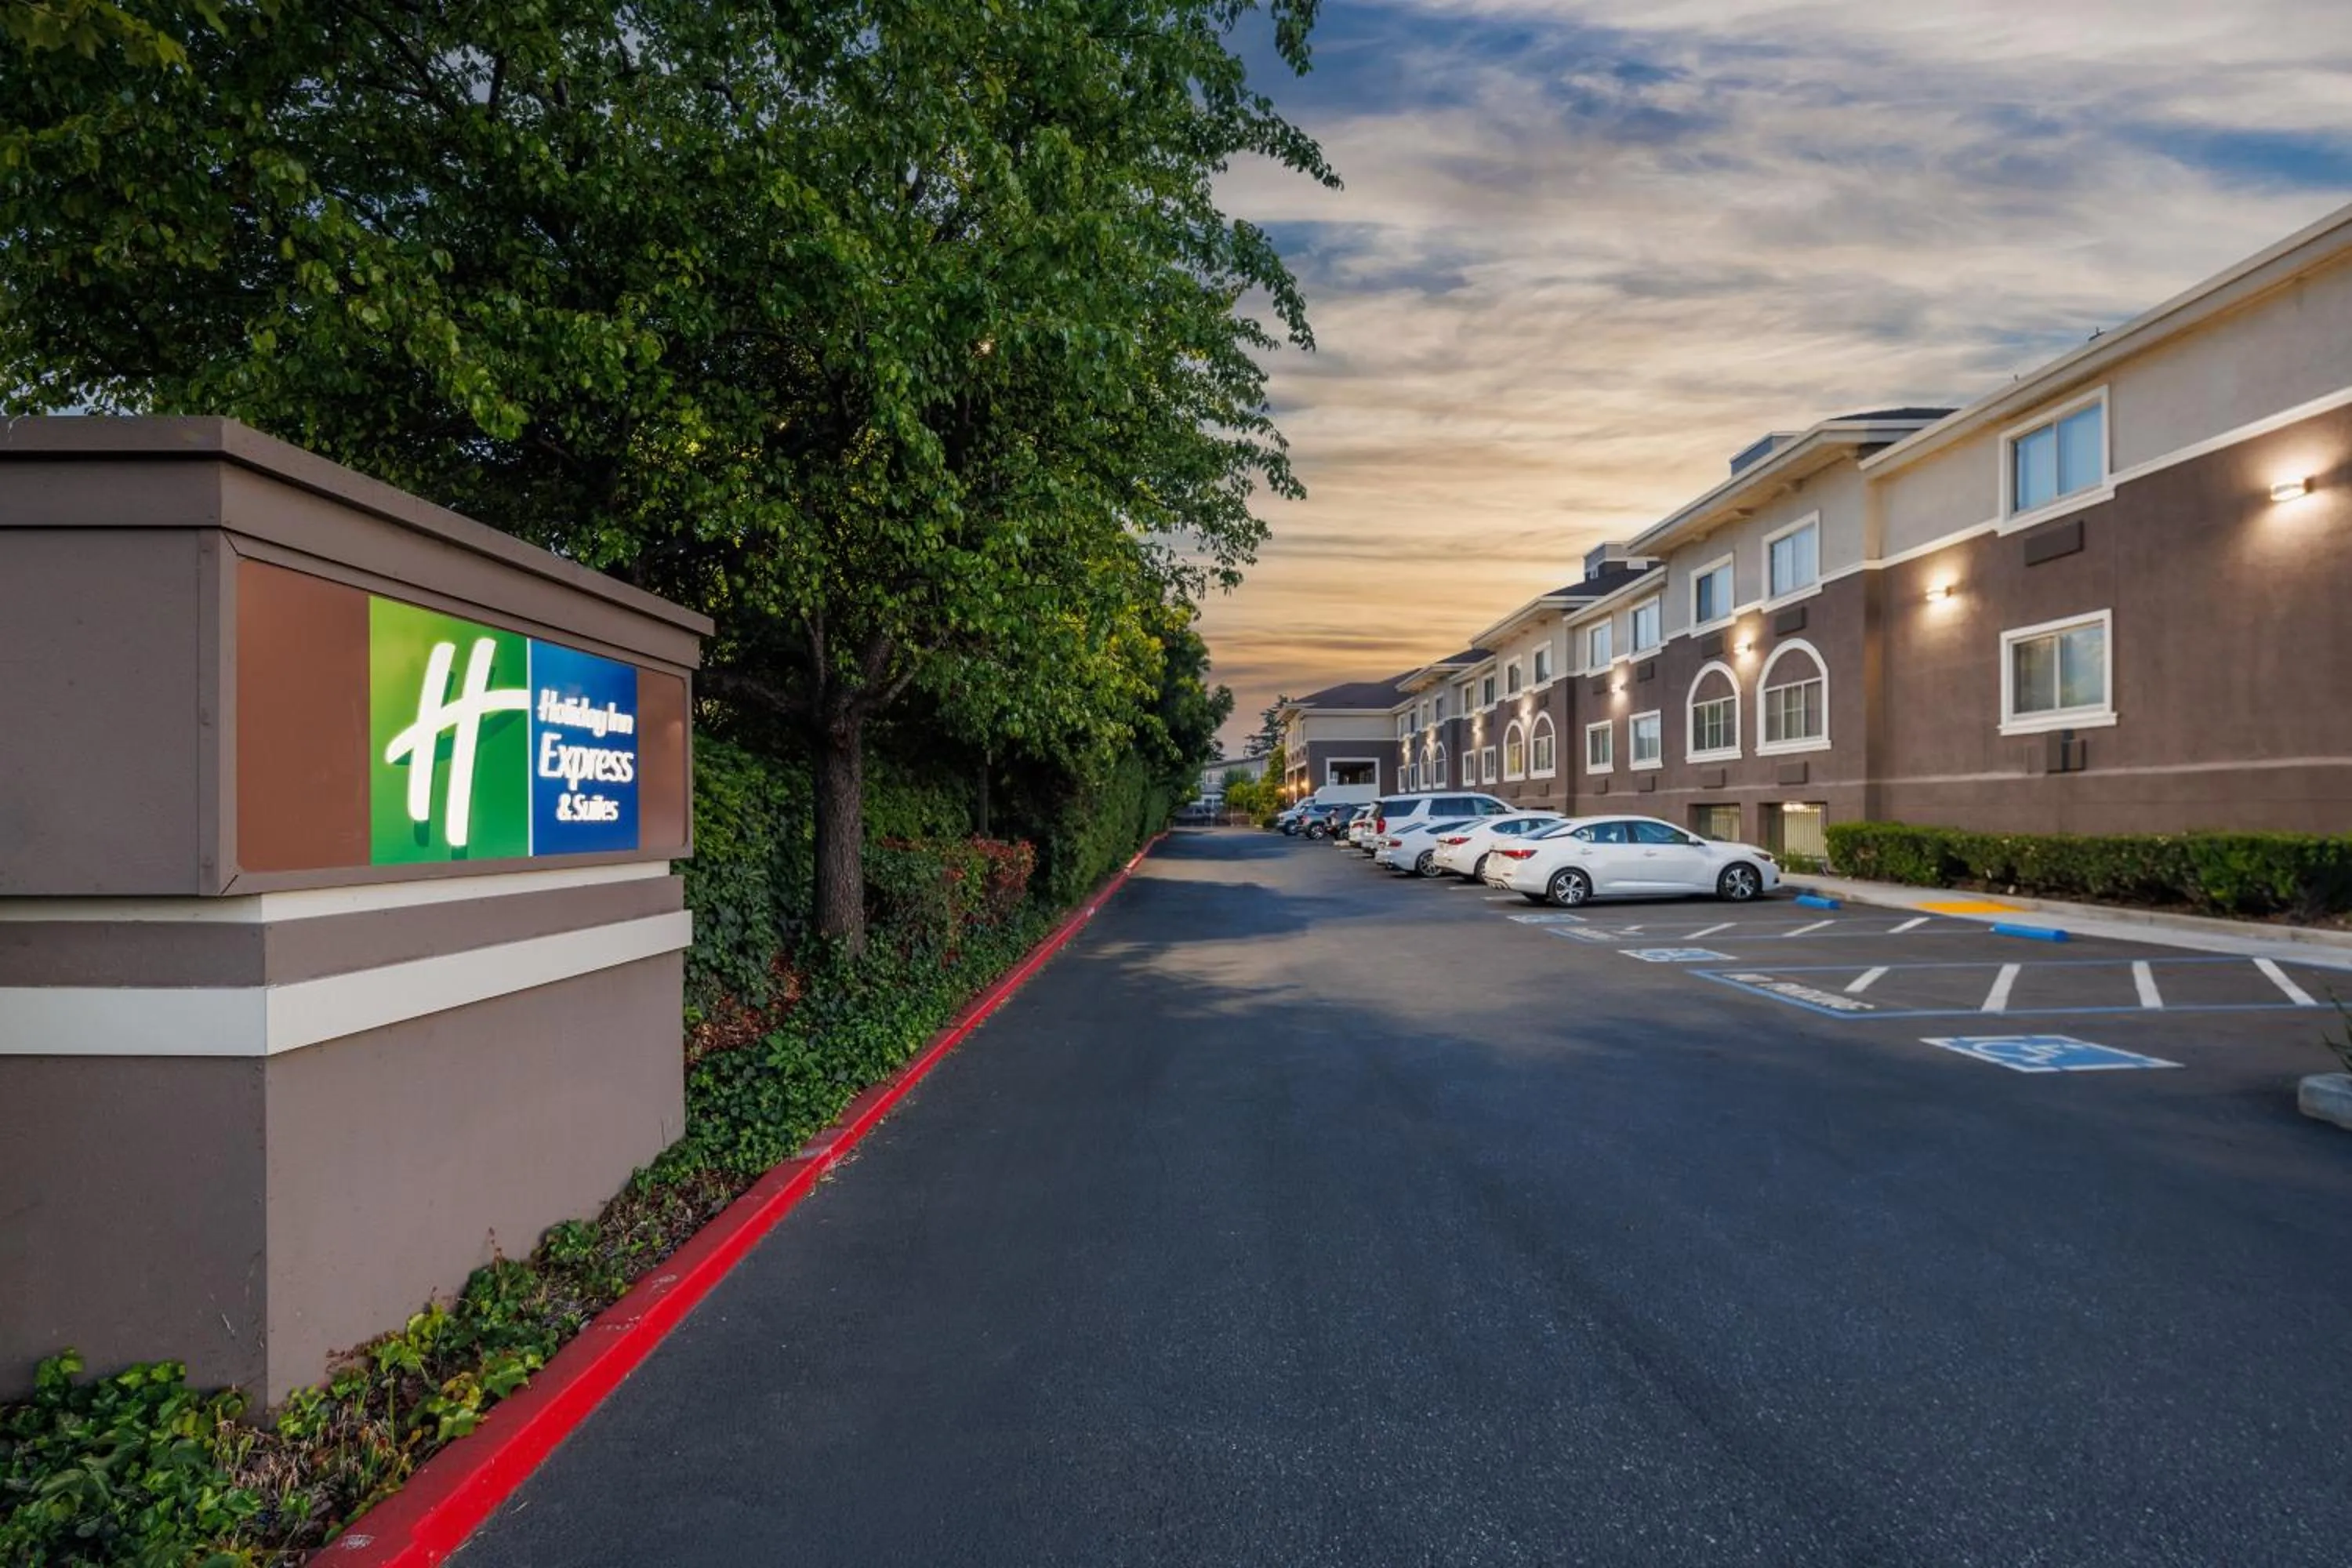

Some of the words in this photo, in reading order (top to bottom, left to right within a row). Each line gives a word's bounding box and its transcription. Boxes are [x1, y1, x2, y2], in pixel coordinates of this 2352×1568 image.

[538, 688, 608, 737] Holiday
[608, 702, 633, 735] Inn
[539, 731, 634, 790] Express
[556, 793, 572, 821] &
[572, 793, 619, 821] Suites
